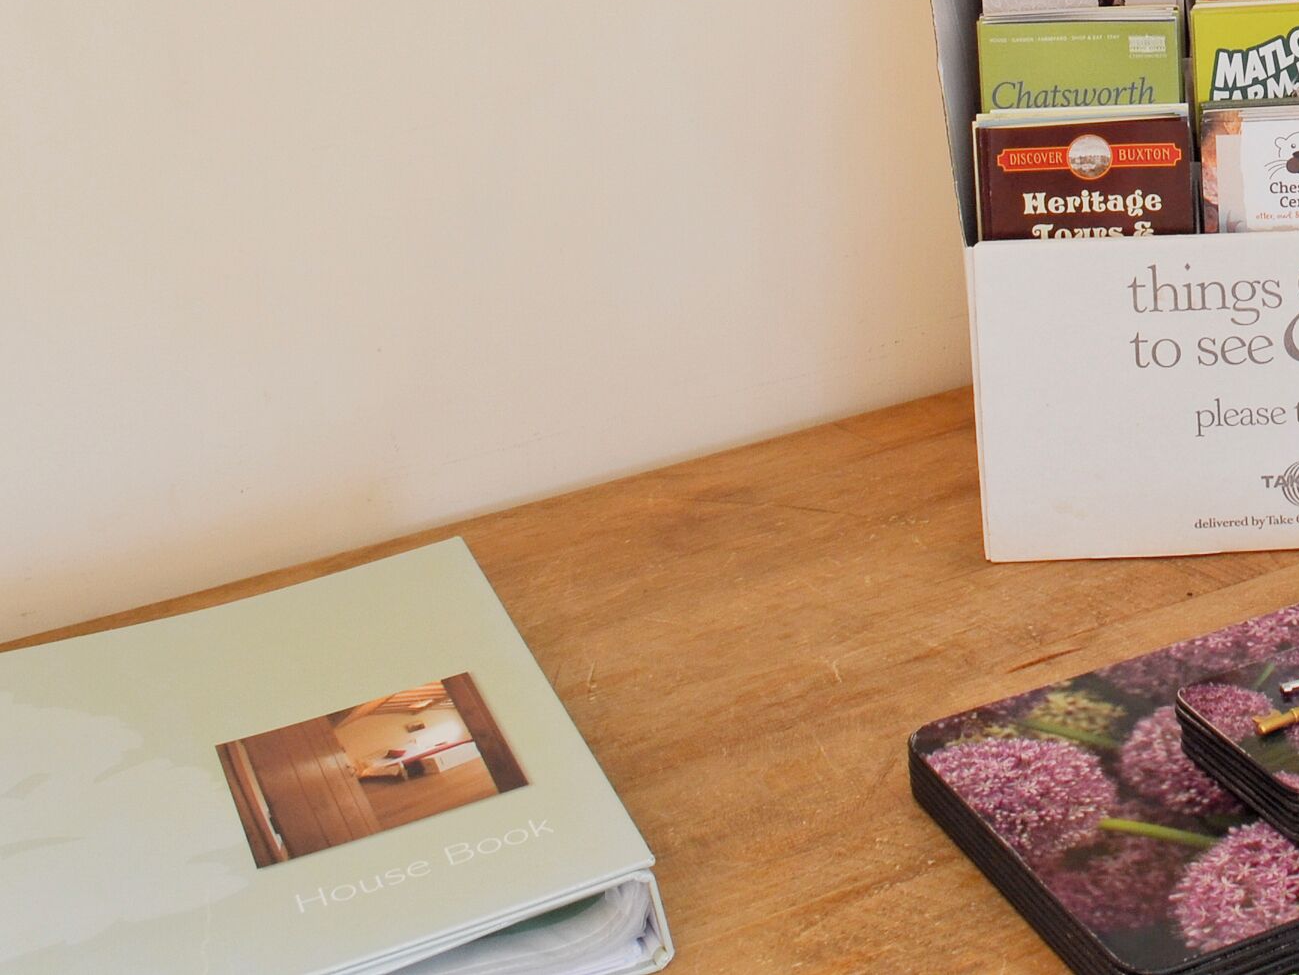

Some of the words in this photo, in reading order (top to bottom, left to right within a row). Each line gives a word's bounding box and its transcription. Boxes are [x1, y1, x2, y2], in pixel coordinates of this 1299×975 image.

[991, 76, 1155, 110] Chatsworth
[1009, 152, 1063, 166] DISCOVER
[1118, 147, 1171, 162] BUXTON
[1022, 189, 1163, 217] Heritage
[1032, 223, 1122, 240] Tours
[1127, 262, 1283, 326] things
[1129, 331, 1182, 369] to
[1197, 332, 1275, 367] see
[1195, 398, 1287, 437] please
[1194, 515, 1248, 529] delivered
[1252, 515, 1265, 530] by
[1265, 514, 1294, 526] Take
[295, 858, 434, 914] House
[443, 818, 555, 868] Book
